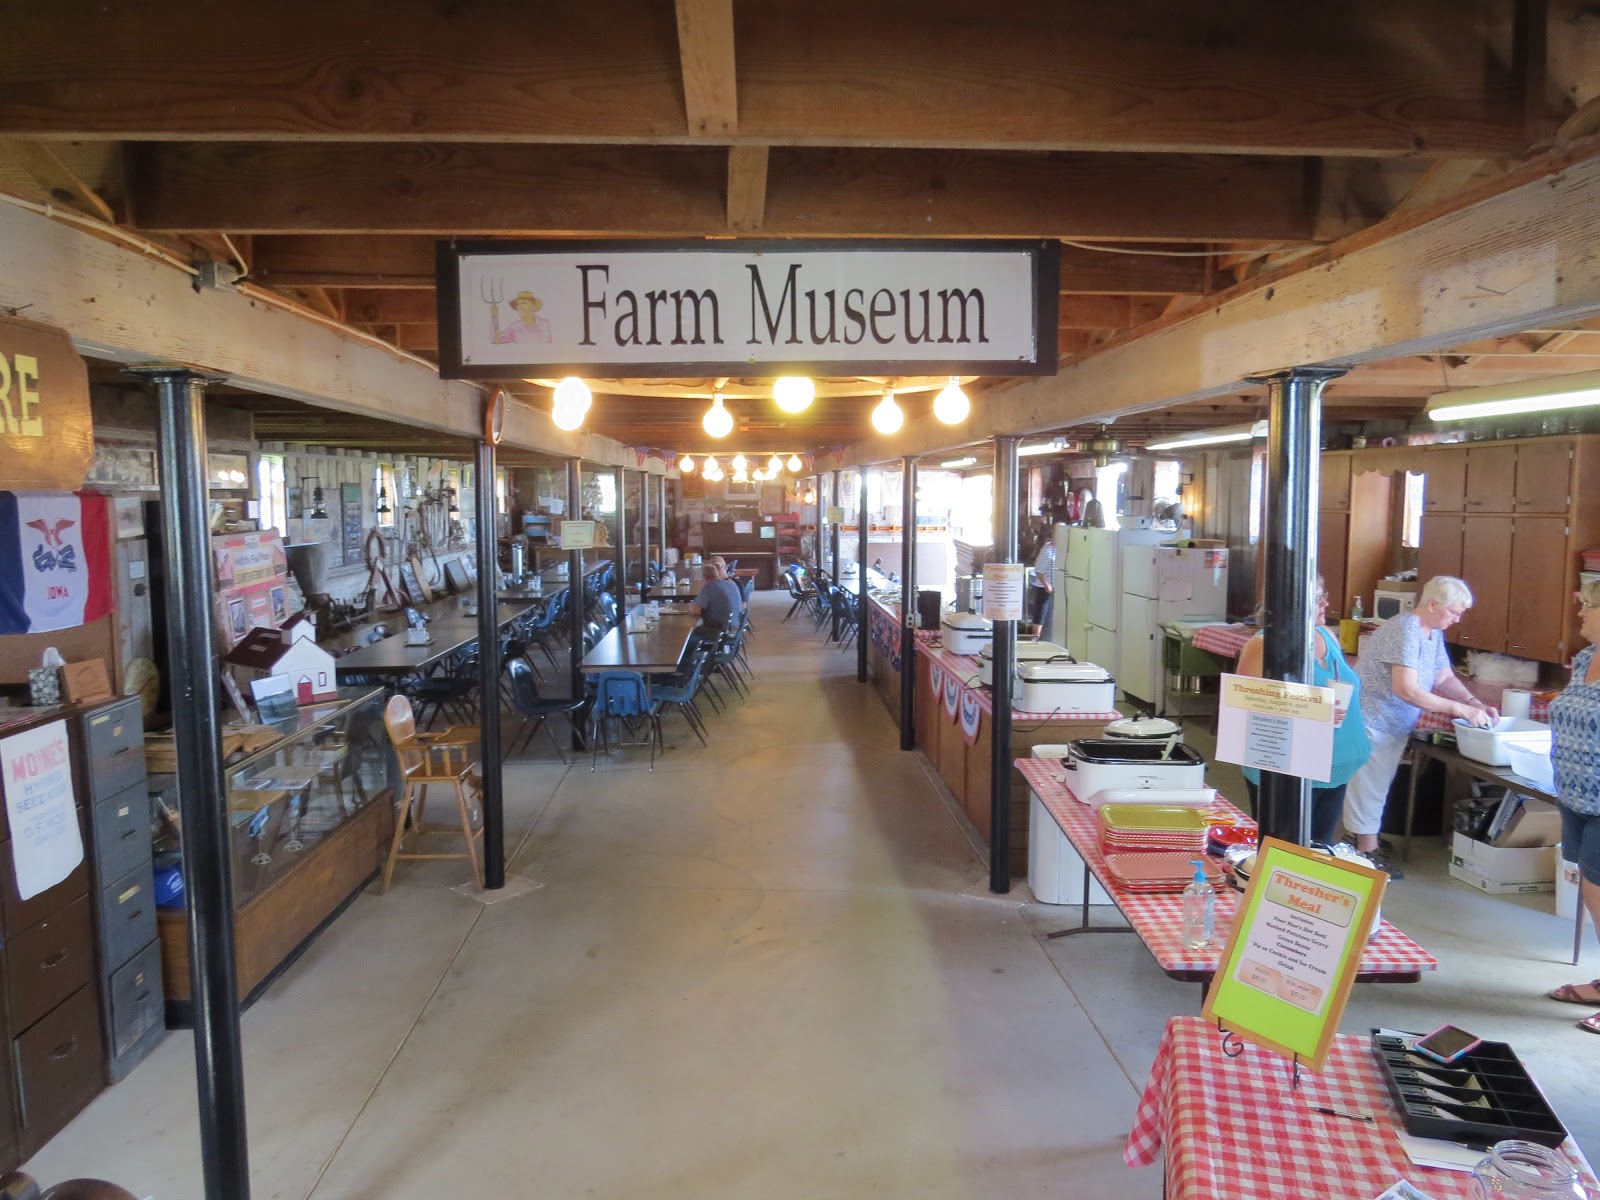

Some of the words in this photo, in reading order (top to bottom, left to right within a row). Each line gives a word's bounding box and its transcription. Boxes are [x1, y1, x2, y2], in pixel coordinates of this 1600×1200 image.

[575, 263, 724, 347] Farm
[745, 262, 989, 347] Museum
[47, 586, 70, 600] IOWA
[1232, 683, 1281, 699] Threshing
[1283, 691, 1323, 704] Festival
[1275, 873, 1351, 907] Thresher's
[1287, 893, 1322, 914] Meal
[1265, 921, 1286, 933] Mashed
[1302, 926, 1313, 934] Hot
[1314, 930, 1327, 939] Beef
[1277, 934, 1294, 944] Green
[1276, 941, 1307, 957] Cucumbers
[1268, 948, 1287, 959] Cookie
[1308, 964, 1327, 975] Cream
